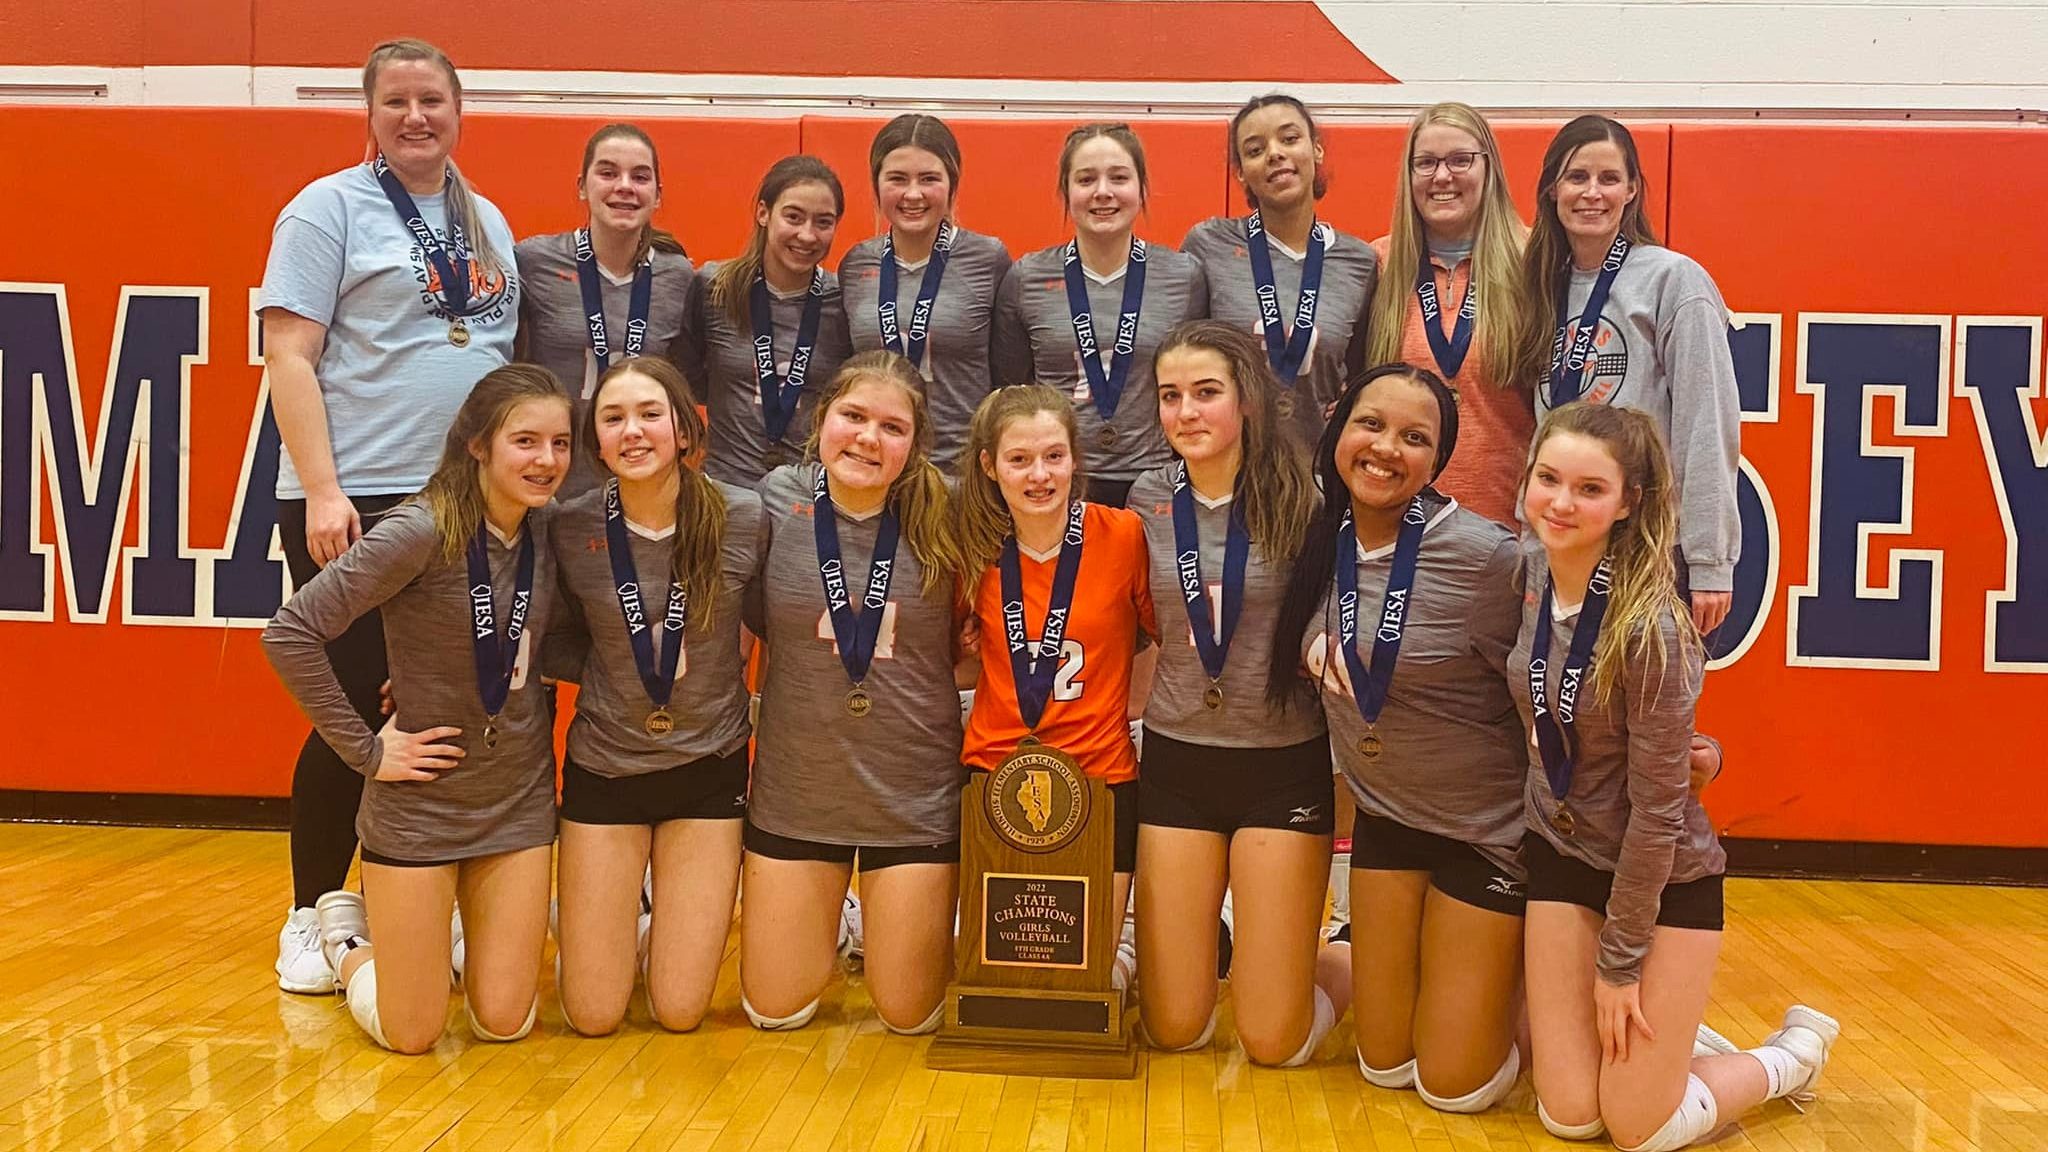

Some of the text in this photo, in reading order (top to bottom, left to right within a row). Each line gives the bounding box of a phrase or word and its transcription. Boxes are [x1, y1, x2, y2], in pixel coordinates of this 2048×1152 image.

[412, 225, 440, 254] IESA
[912, 299, 932, 331] IESA
[1261, 293, 1279, 326] IESA
[1299, 289, 1316, 319] IESA
[1421, 291, 1438, 322] IESA
[590, 312, 606, 347] IESA
[626, 327, 643, 359] IESA
[881, 310, 897, 344] IESA
[1077, 321, 1096, 358] IESA
[1117, 312, 1137, 343] IESA
[1573, 326, 1593, 362] IESA
[757, 345, 773, 379] IESA
[791, 345, 811, 379] IESA
[825, 570, 847, 612] IESA
[869, 559, 891, 598] IESA
[1181, 562, 1200, 603] IESA
[474, 597, 494, 639] IESA
[511, 590, 529, 630] IESA
[622, 597, 646, 635] IESA
[1342, 605, 1354, 645] IESA
[1382, 588, 1407, 630] IESA
[1007, 613, 1025, 653] IESA
[1043, 607, 1066, 647] IESA
[1531, 673, 1547, 718] IESA
[1559, 667, 1582, 713] IESA
[992, 756, 1081, 838] ILLINOIS ELEMENTARY SCHOOL ASSOCIATION
[1014, 894, 1057, 906] STATE
[1026, 883, 1046, 892] 2022
[994, 907, 1076, 926] CHAMPIONS
[1019, 922, 1051, 932] GIRLS
[1000, 931, 1071, 943] VOLLEYBALL
[1030, 945, 1055, 953] GRADE
